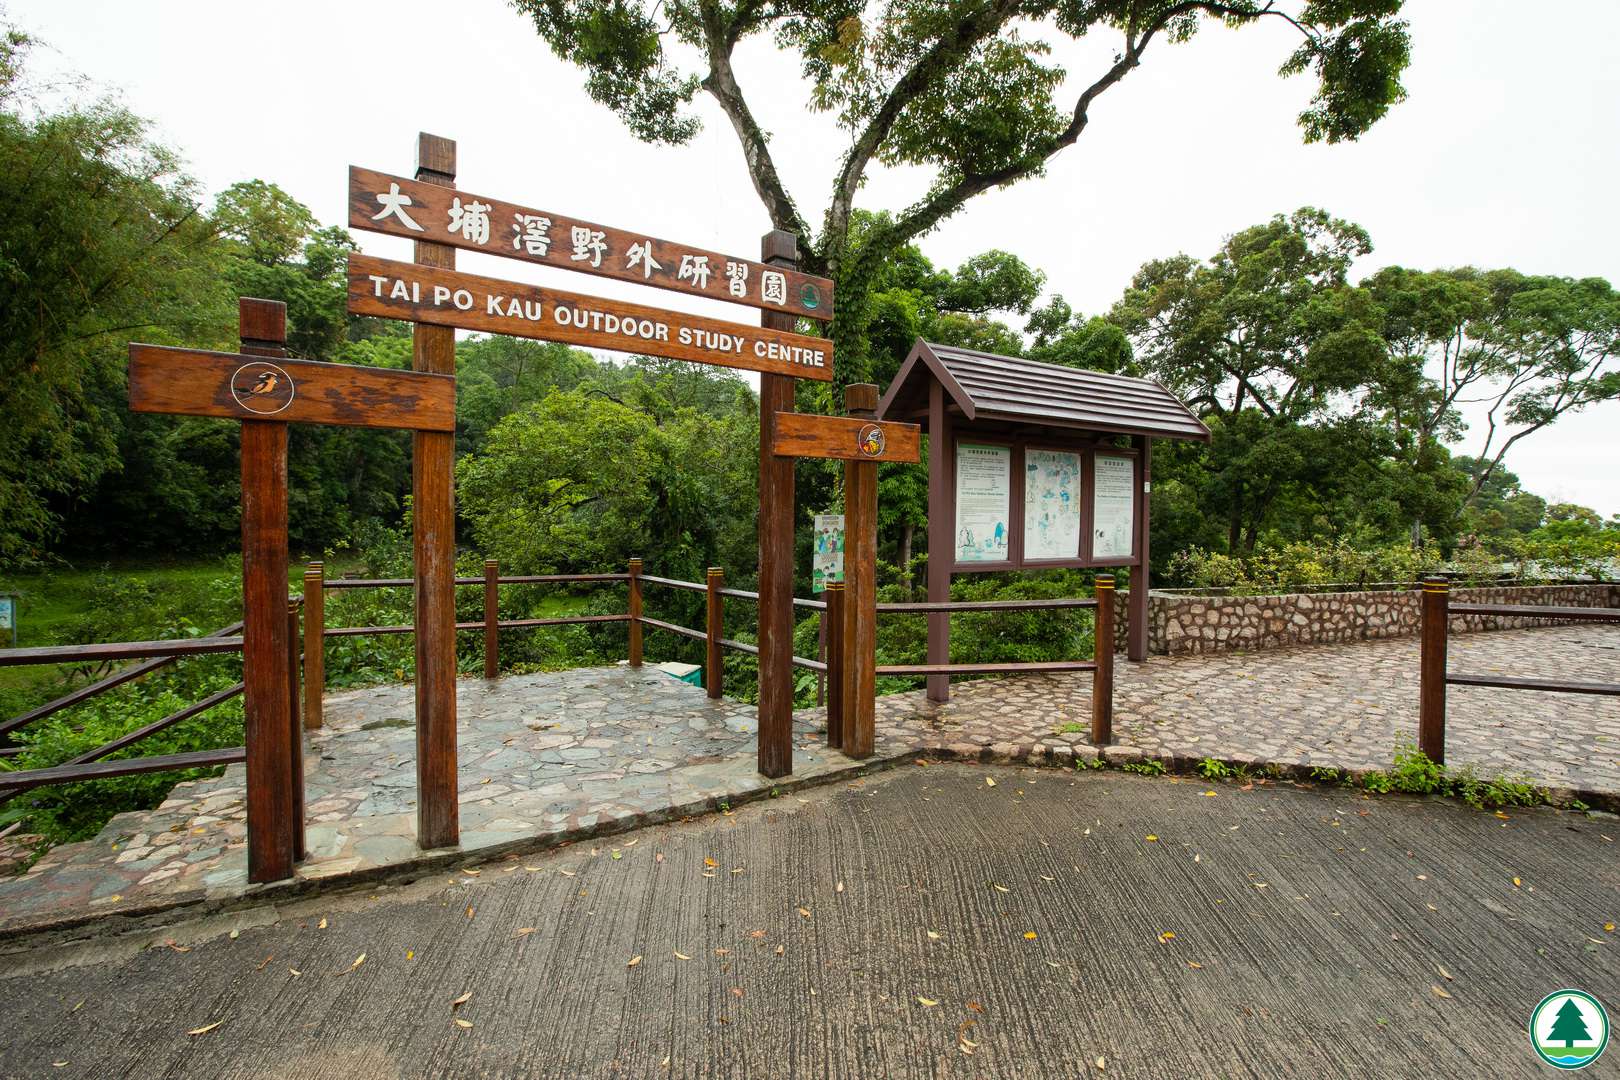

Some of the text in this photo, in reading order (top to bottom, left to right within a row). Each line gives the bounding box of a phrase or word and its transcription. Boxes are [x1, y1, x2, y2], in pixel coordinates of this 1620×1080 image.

[372, 183, 787, 306] 大埔滘野外研習園
[369, 275, 824, 367] TAI PO KAU OUTDOOR STUDY CENTRE
